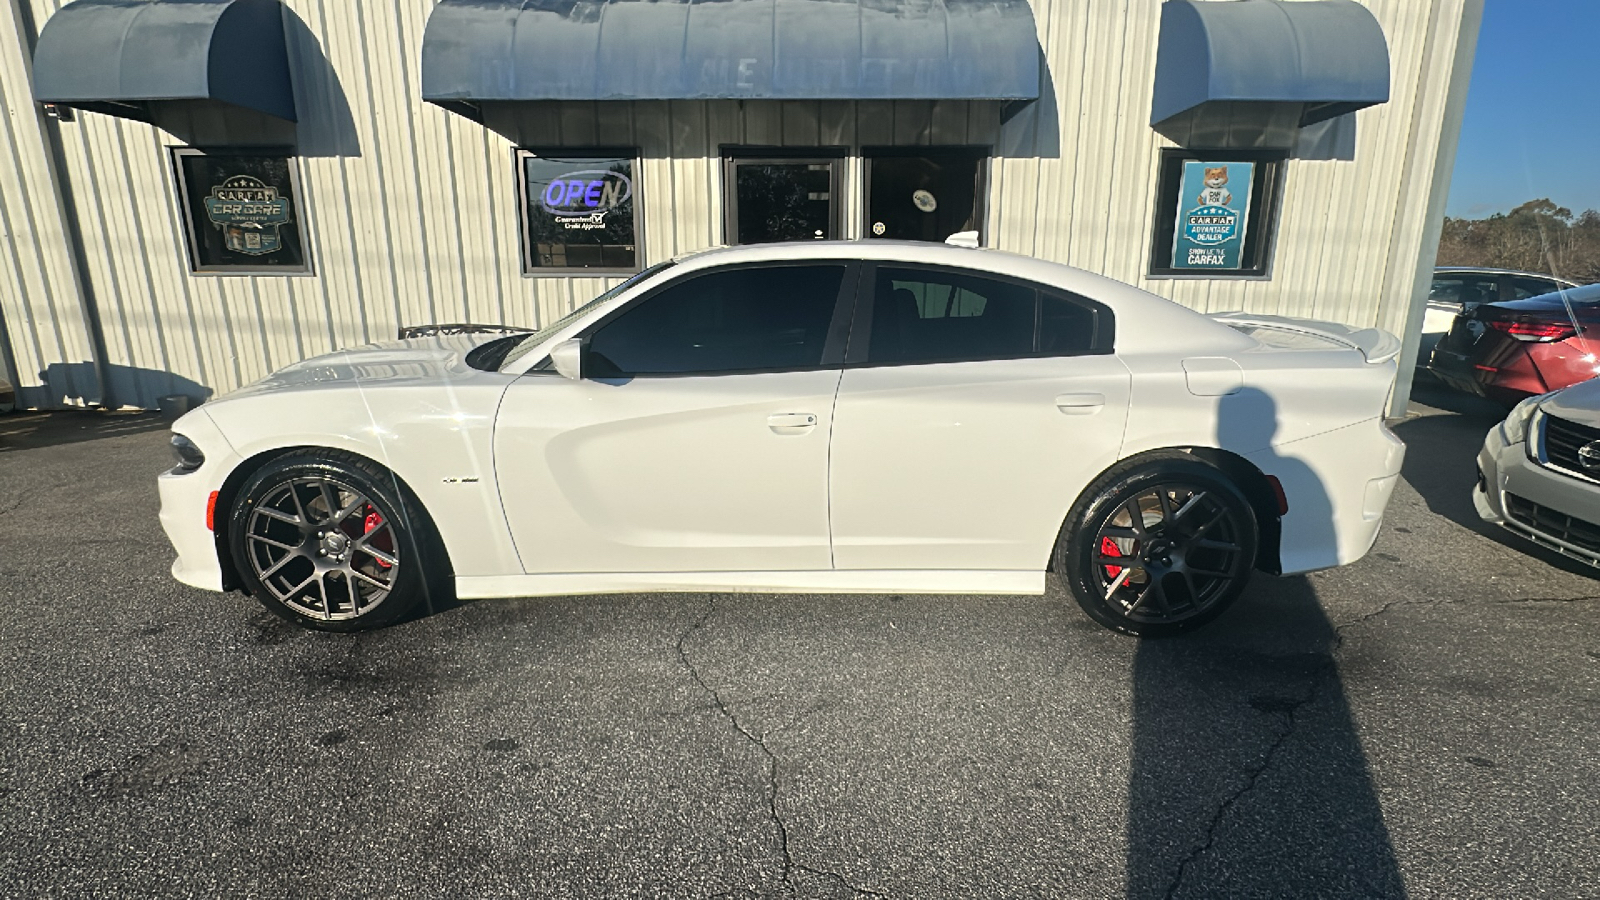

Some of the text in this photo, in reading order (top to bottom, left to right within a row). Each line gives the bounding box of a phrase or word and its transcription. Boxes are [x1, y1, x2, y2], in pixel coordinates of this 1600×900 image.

[218, 191, 273, 201] CARFAX
[546, 180, 622, 209] OPEN
[213, 204, 281, 215] CAR CARE
[1190, 217, 1234, 225] CARFAX
[1191, 226, 1230, 234] ADVANTAGE
[1197, 233, 1223, 241] DEALER
[1188, 255, 1226, 265] CARFAX
